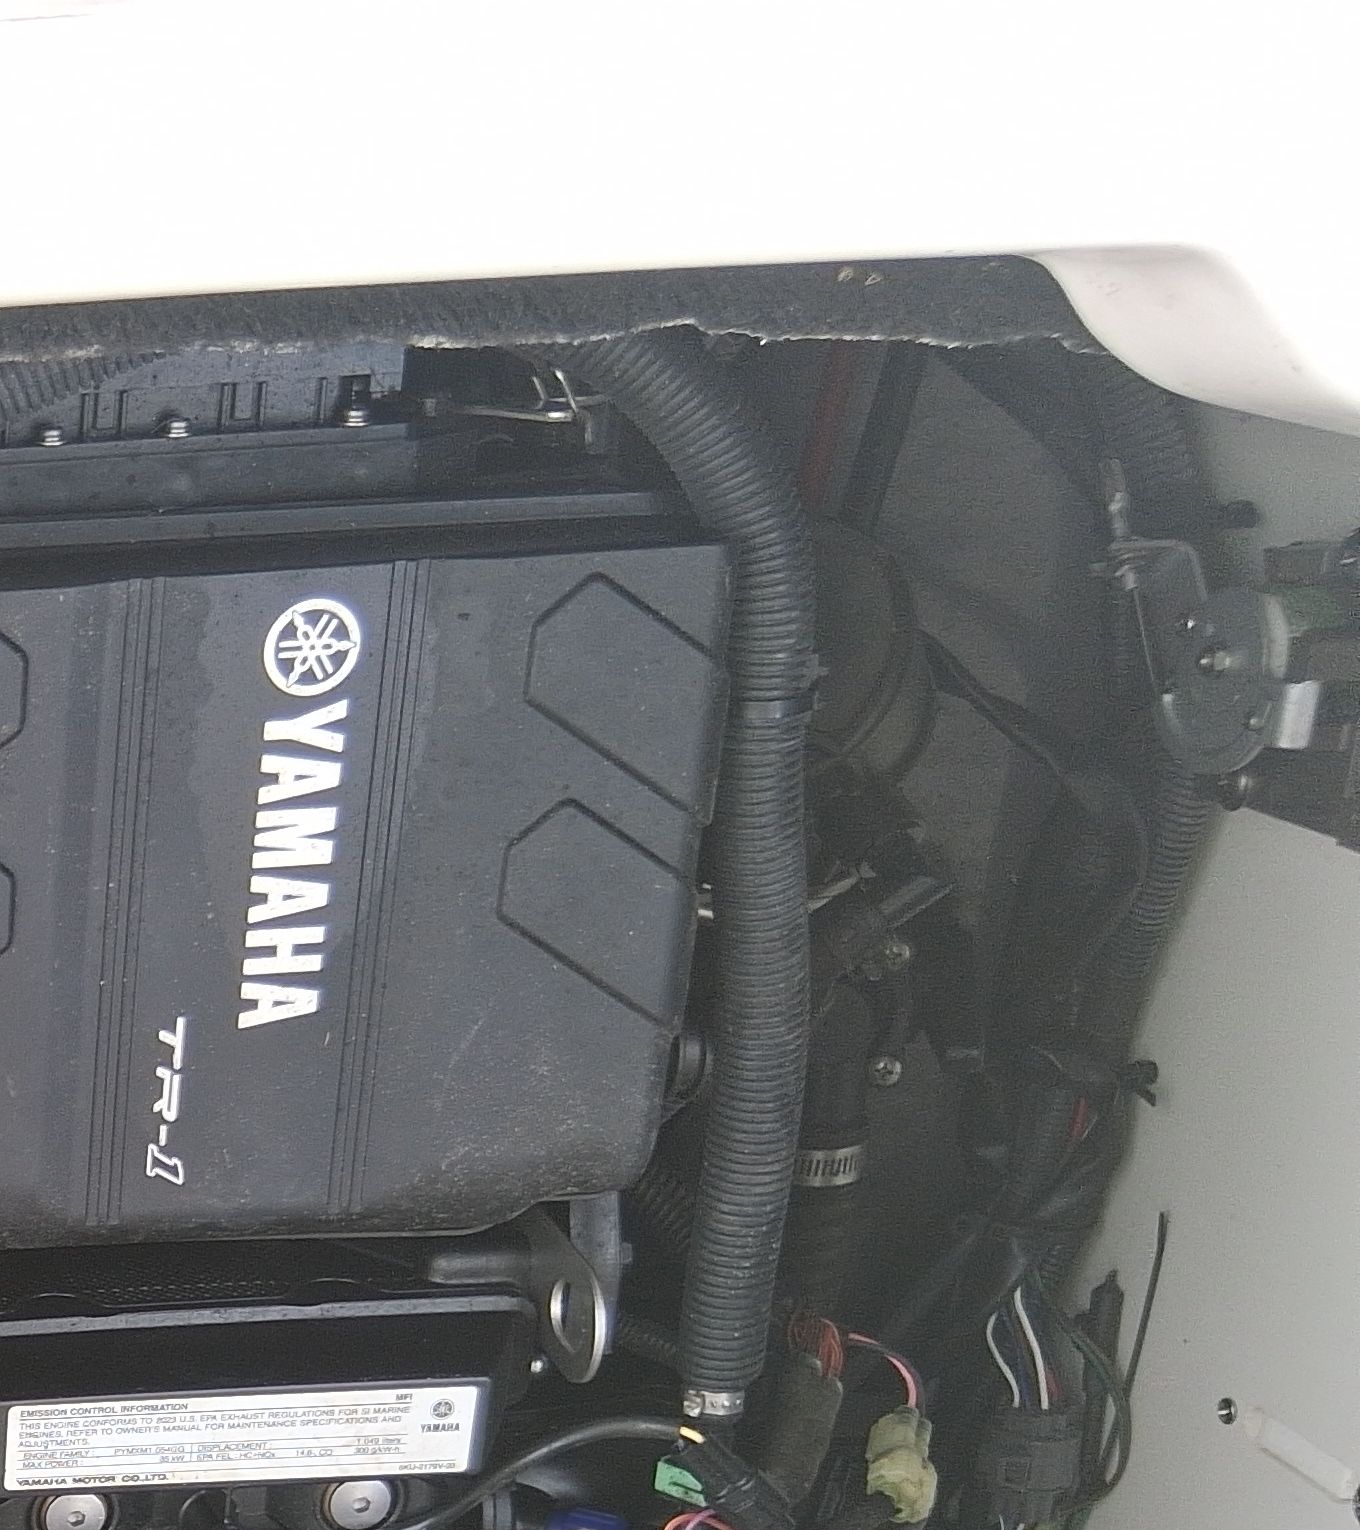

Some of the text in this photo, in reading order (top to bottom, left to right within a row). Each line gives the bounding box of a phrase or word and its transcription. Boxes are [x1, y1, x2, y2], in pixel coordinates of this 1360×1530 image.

[237, 698, 350, 1029] YAMAHA
[145, 1016, 188, 1186] TR-1
[18, 1421, 40, 1430] THIS
[43, 1419, 79, 1429] ENGINE
[82, 1417, 137, 1427] CONFORMS
[139, 1416, 152, 1424] TO
[199, 1413, 217, 1422] EPA
[220, 1411, 264, 1421] EXHAUST
[267, 1408, 335, 1419] REGULATIONS
[337, 1407, 358, 1416] FOR
[372, 1405, 410, 1414] MARINE
[20, 1402, 188, 1417] EMISSION CONTROL INFORMATION
[66, 1428, 98, 1437] REFER
[100, 1427, 112, 1436] TO
[114, 1425, 160, 1435] OWNER'S
[162, 1423, 202, 1433] MANUAL
[204, 1422, 224, 1431] FOR
[227, 1419, 297, 1430] MAINTENANCE
[299, 1416, 378, 1427] SPECIFICATIONS
[380, 1415, 402, 1423] AND
[419, 1422, 460, 1433] YAMAHA
[16, 1477, 67, 1487] YAMAHA
[71, 1475, 116, 1485] MOTOR
